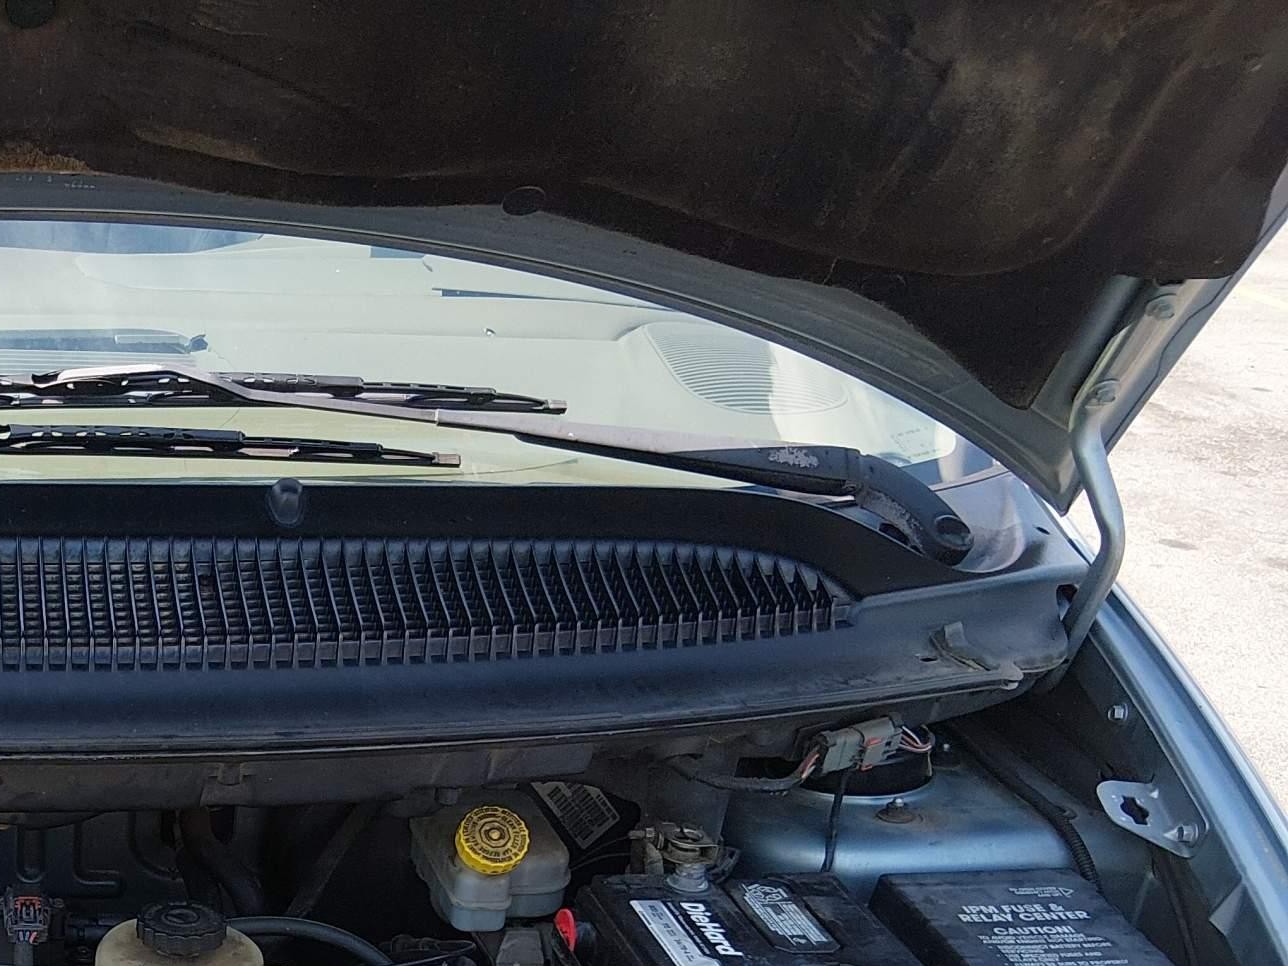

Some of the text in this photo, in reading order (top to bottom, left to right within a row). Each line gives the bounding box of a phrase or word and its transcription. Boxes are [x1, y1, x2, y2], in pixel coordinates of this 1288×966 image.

[962, 903, 1065, 914] IPM FUSE &
[958, 910, 1091, 923] RELAY CENTER
[680, 902, 744, 957] DieHard
[993, 925, 1076, 935] CAUTION!
